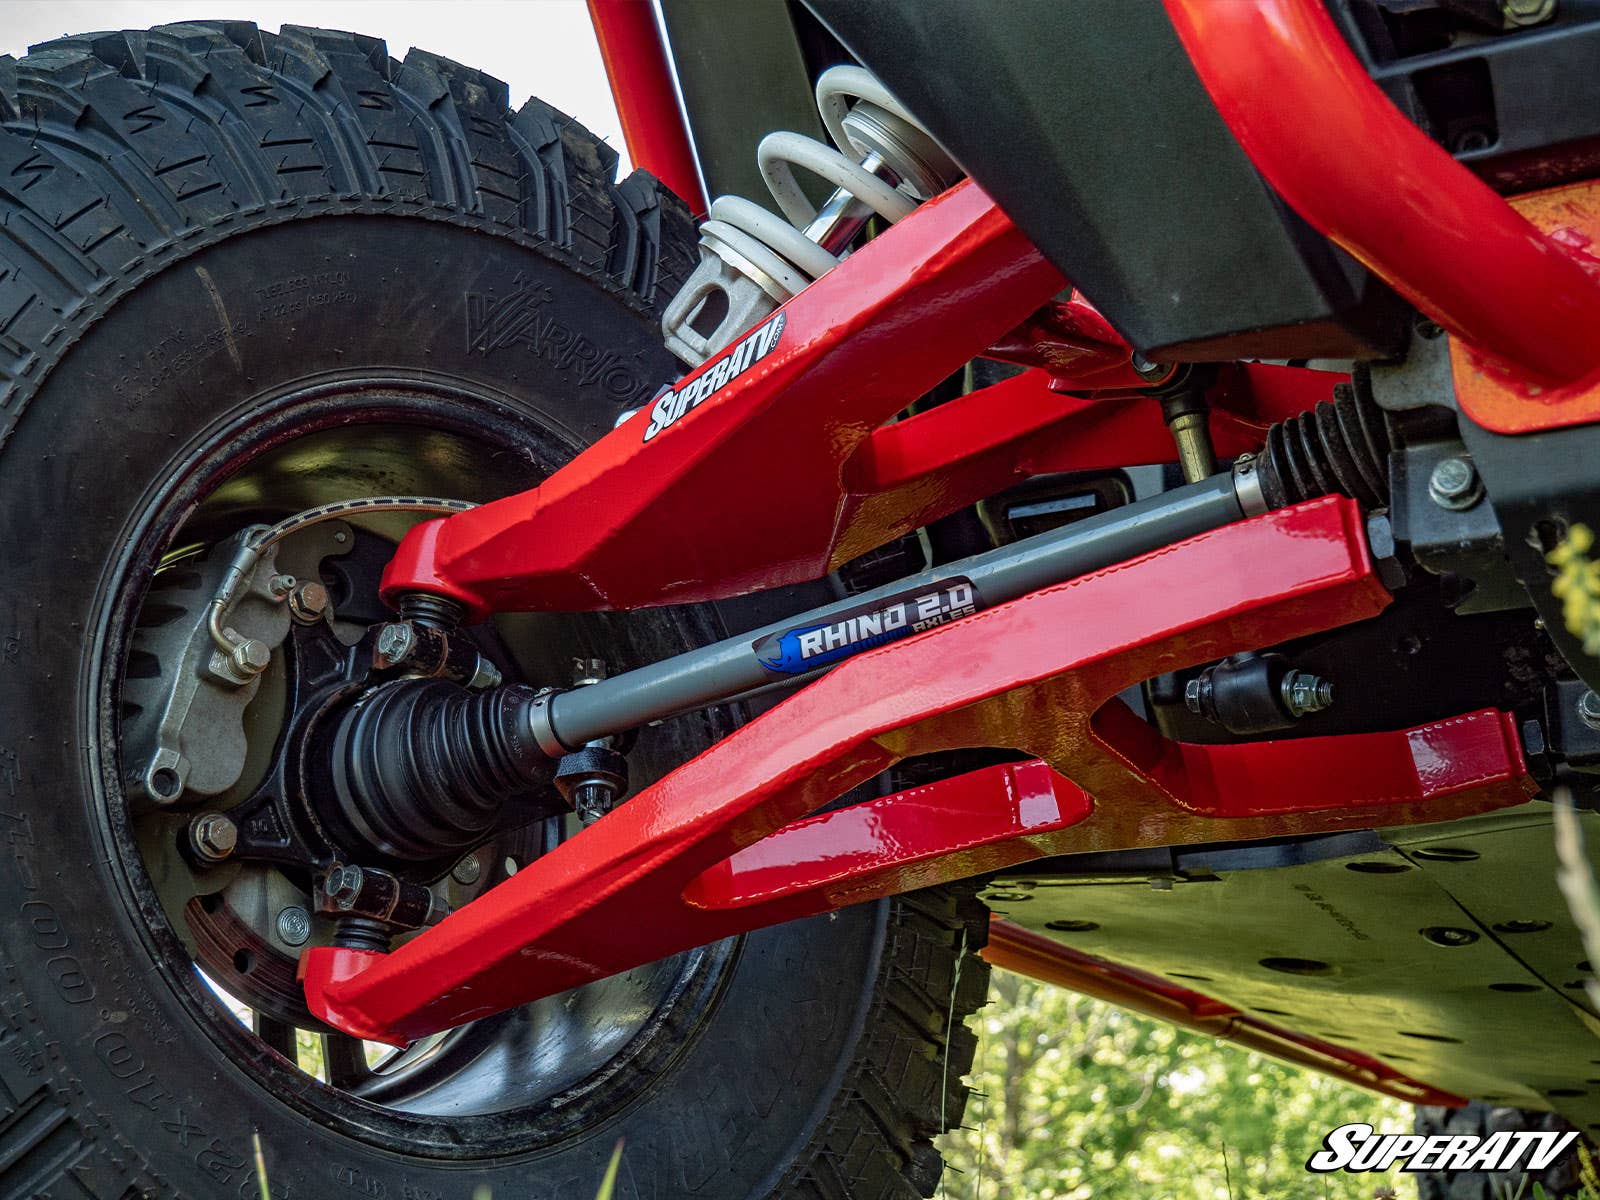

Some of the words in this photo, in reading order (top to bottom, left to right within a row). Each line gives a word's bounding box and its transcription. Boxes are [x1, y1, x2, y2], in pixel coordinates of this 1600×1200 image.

[644, 314, 783, 442] SUPERATV
[799, 603, 907, 659] RHINO
[915, 583, 972, 618] 2.0
[912, 605, 976, 633] AXLES
